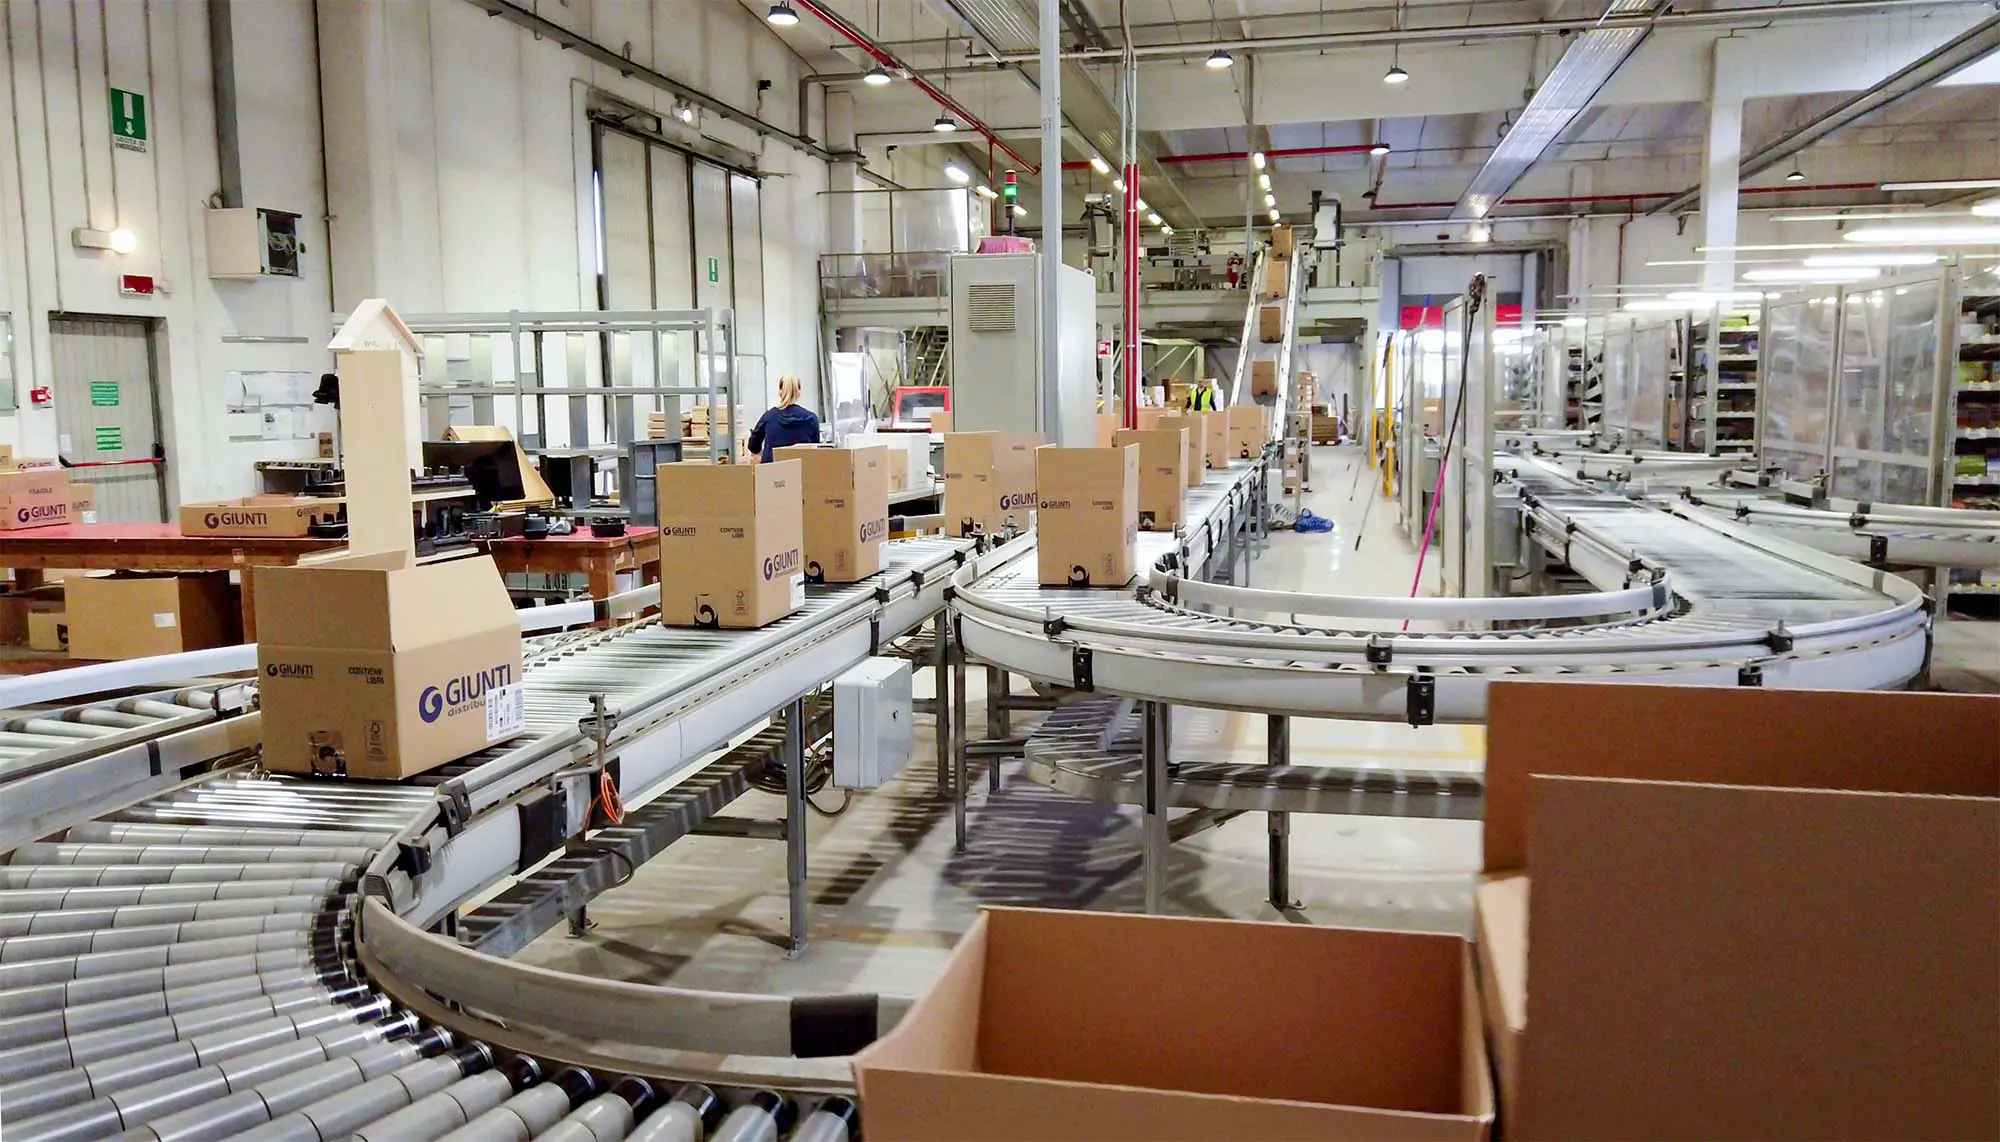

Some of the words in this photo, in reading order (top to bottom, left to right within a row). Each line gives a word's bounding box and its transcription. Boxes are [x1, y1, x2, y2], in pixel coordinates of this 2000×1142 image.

[1011, 492, 1038, 506] GIUNT
[31, 503, 67, 518] GIUNTI
[220, 512, 268, 526] GIUNTI
[672, 527, 697, 535] GIUNTI
[773, 548, 799, 572] GIUNTI
[279, 663, 314, 676] GIUNTI
[445, 663, 512, 706] GIUNTI
[447, 696, 487, 717] distribu
